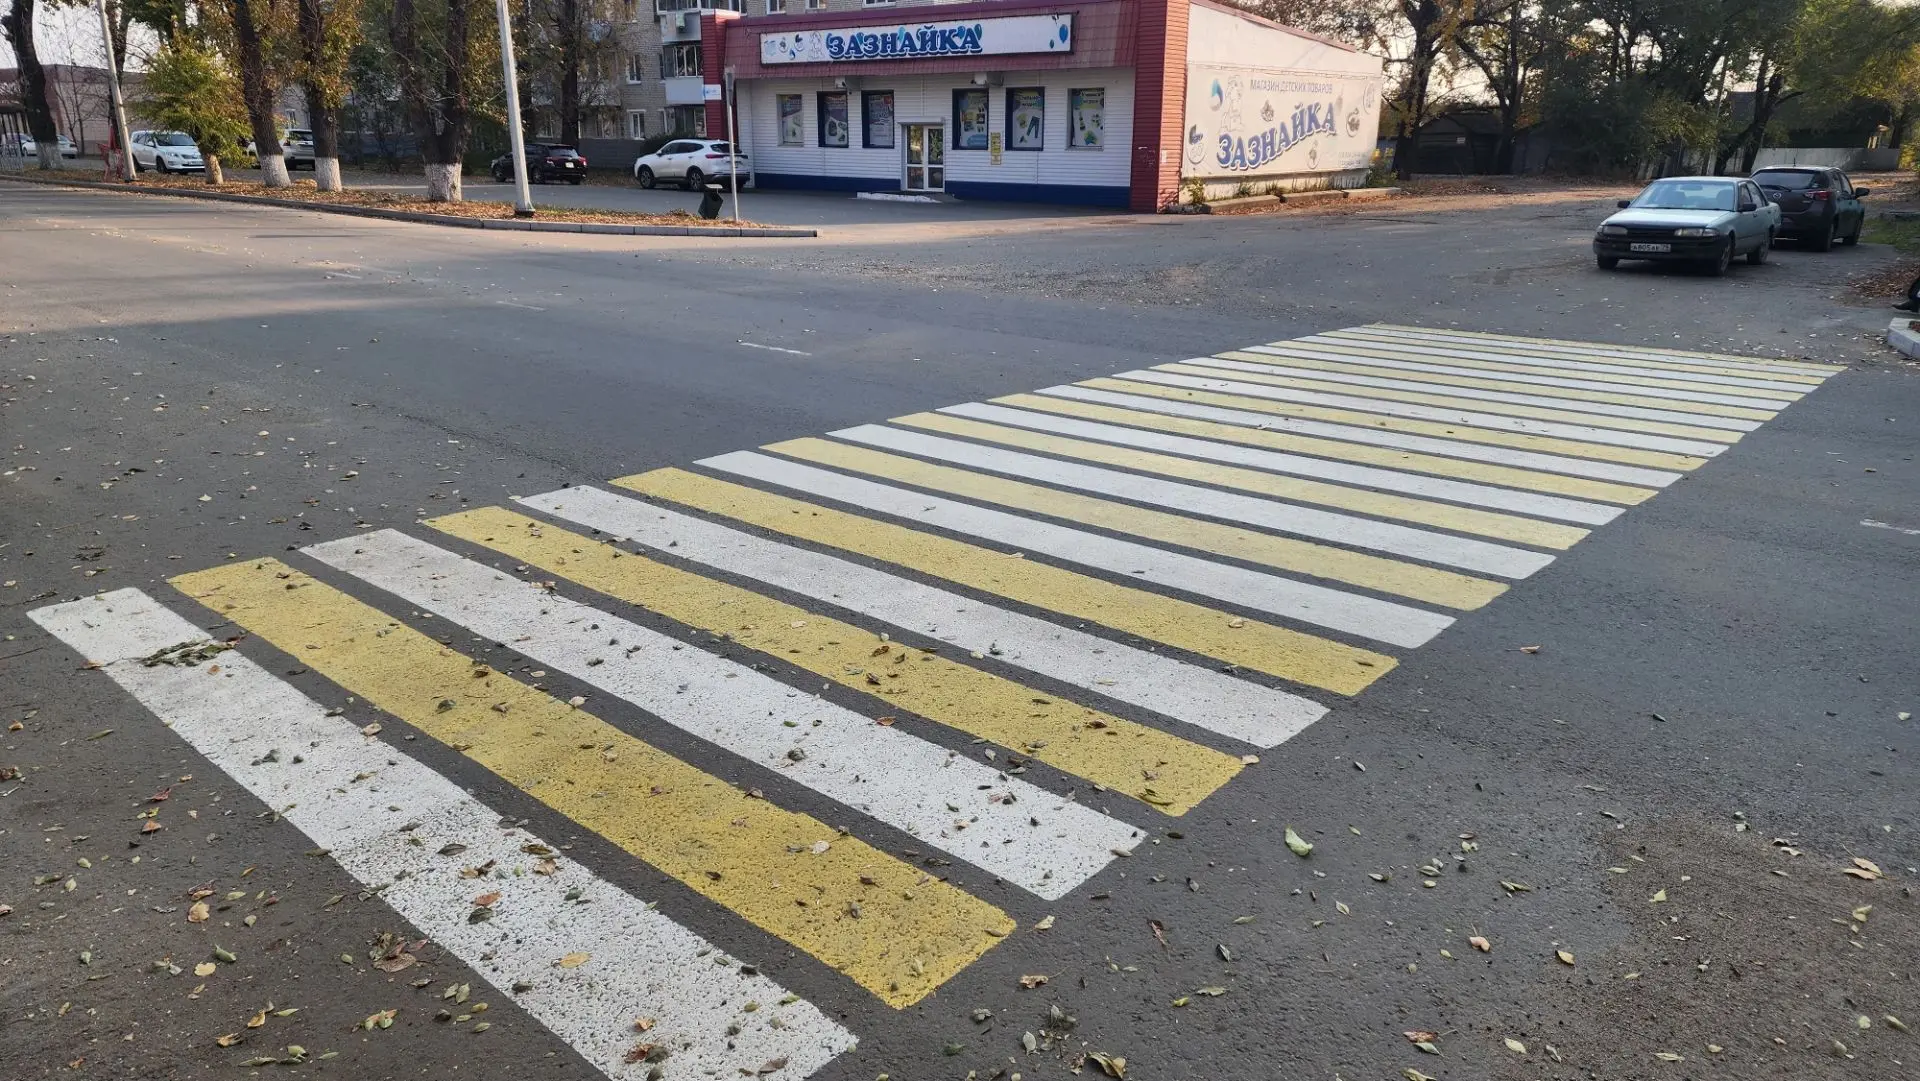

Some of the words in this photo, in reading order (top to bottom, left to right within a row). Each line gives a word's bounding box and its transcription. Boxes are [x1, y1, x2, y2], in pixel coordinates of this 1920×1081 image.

[828, 24, 983, 59] ЗАЗНАЙКА
[1250, 79, 1280, 92] МАГАЗИН
[1280, 80, 1306, 93] ДЕТСКИХ
[1306, 82, 1333, 94] ТОВАРОВ
[1216, 102, 1337, 171] ЗАЗНАЙКА
